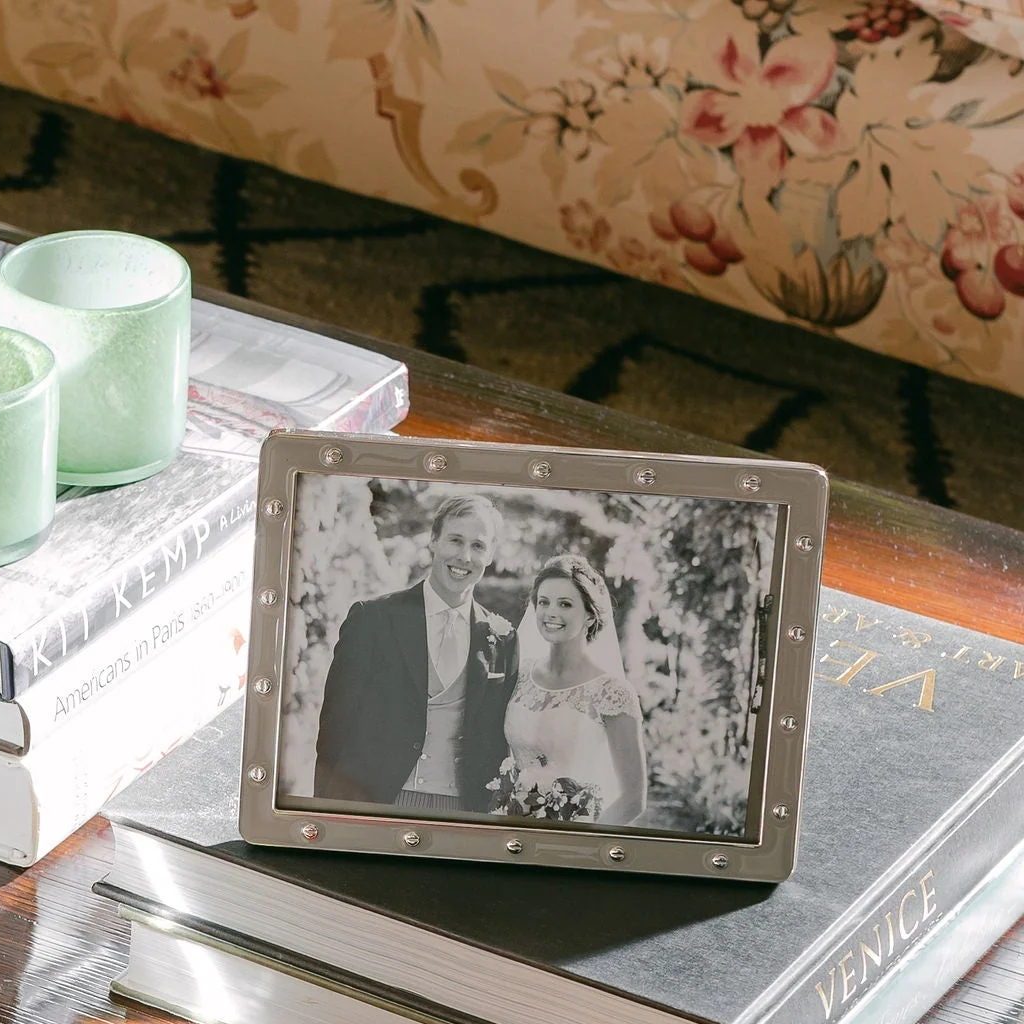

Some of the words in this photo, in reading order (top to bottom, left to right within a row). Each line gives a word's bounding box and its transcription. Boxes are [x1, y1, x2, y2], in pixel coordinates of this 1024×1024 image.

[30, 606, 90, 677] KIT
[112, 518, 211, 619] KEMP
[219, 515, 229, 532] A
[230, 499, 257, 525] Livin
[822, 605, 884, 632] AR
[54, 651, 132, 722] Americans
[135, 638, 149, 663] in
[151, 611, 185, 650] Paris
[813, 640, 936, 713] VE
[814, 871, 937, 1019] VENICE
